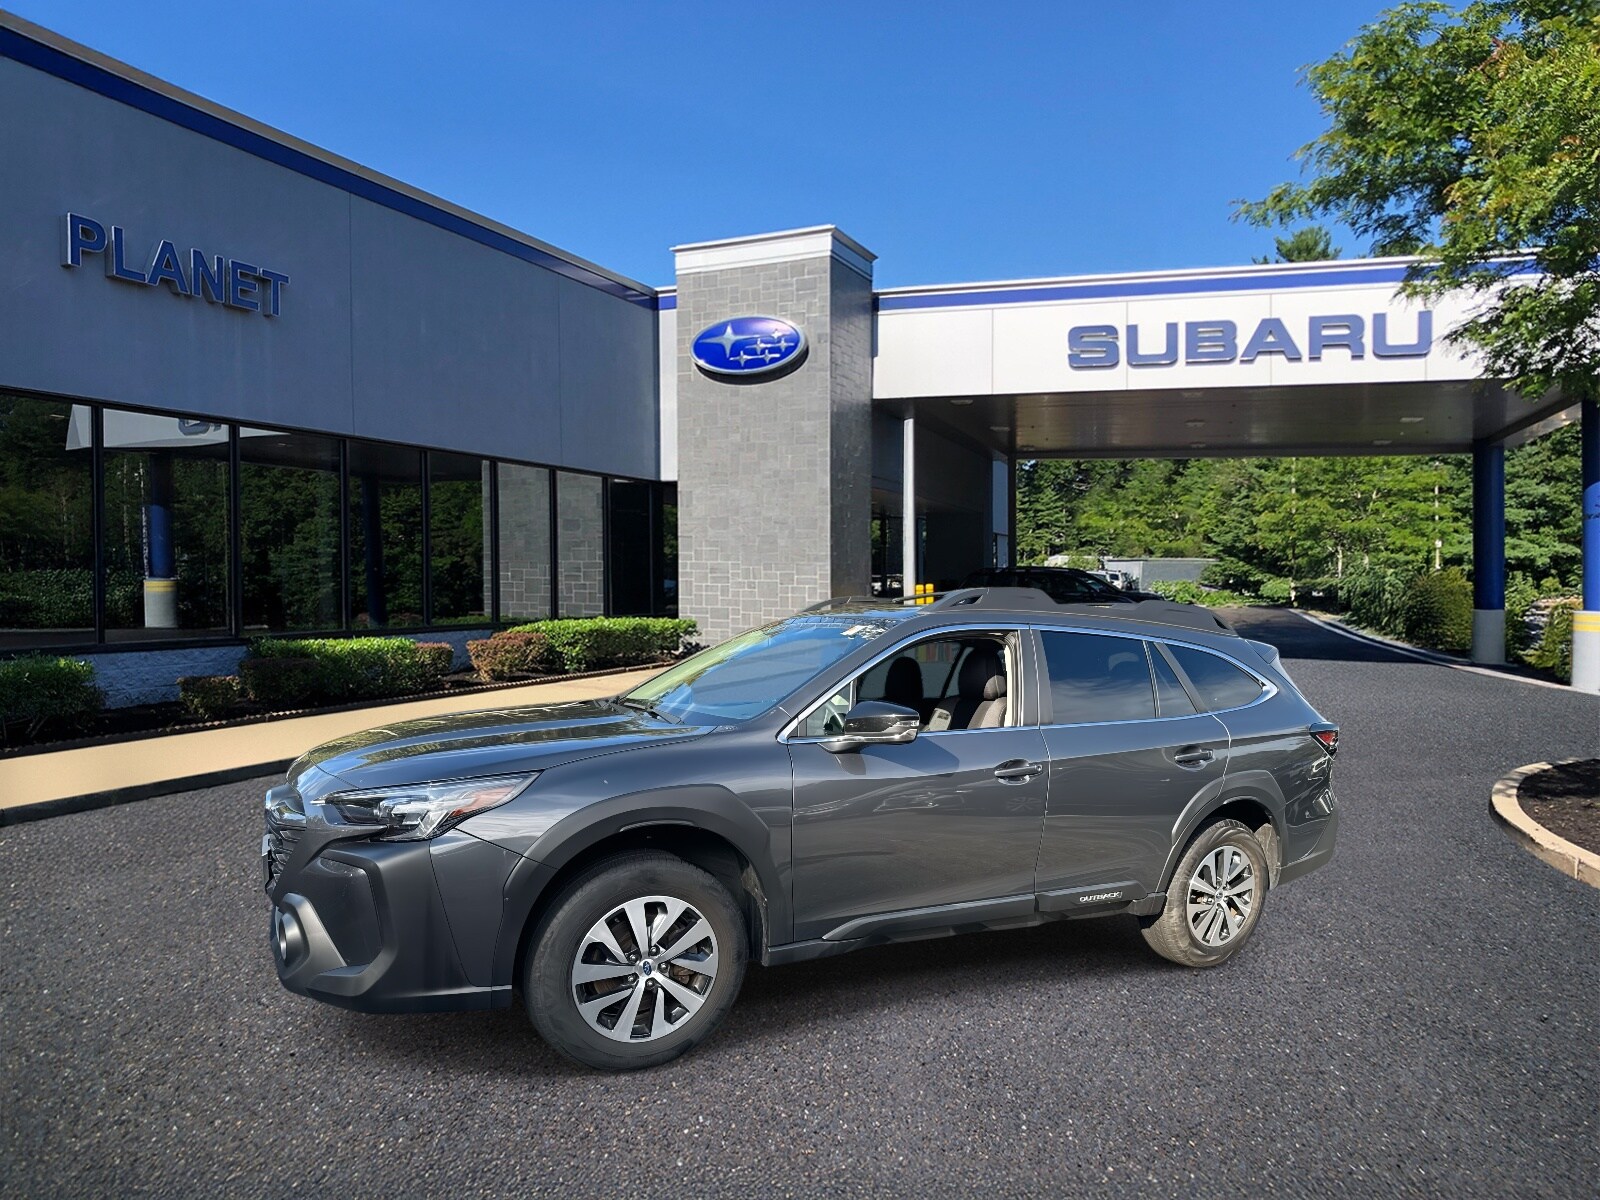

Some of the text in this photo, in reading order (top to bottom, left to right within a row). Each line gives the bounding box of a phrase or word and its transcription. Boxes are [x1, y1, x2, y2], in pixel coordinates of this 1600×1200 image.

[66, 212, 290, 317] PLANET
[1068, 311, 1432, 369] SUBARU
[1079, 891, 1121, 903] OUTBACK
